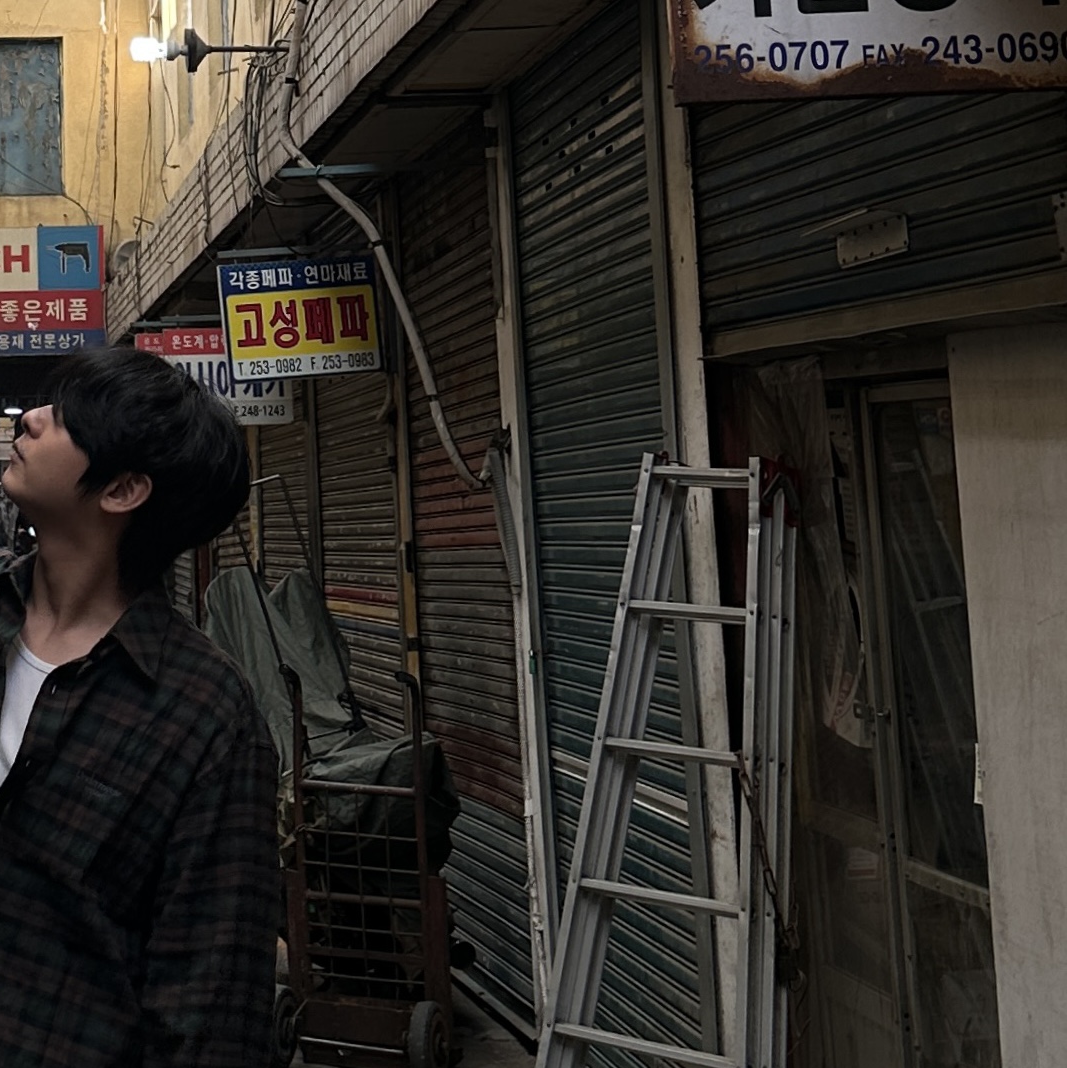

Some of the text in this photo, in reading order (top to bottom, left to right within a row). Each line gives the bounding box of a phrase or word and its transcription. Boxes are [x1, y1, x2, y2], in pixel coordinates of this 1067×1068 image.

[695, 40, 849, 74] 256-0707
[0, 298, 89, 323] 좋은제품
[235, 294, 369, 349] 고성페파
[29, 333, 85, 349] 전문상가
